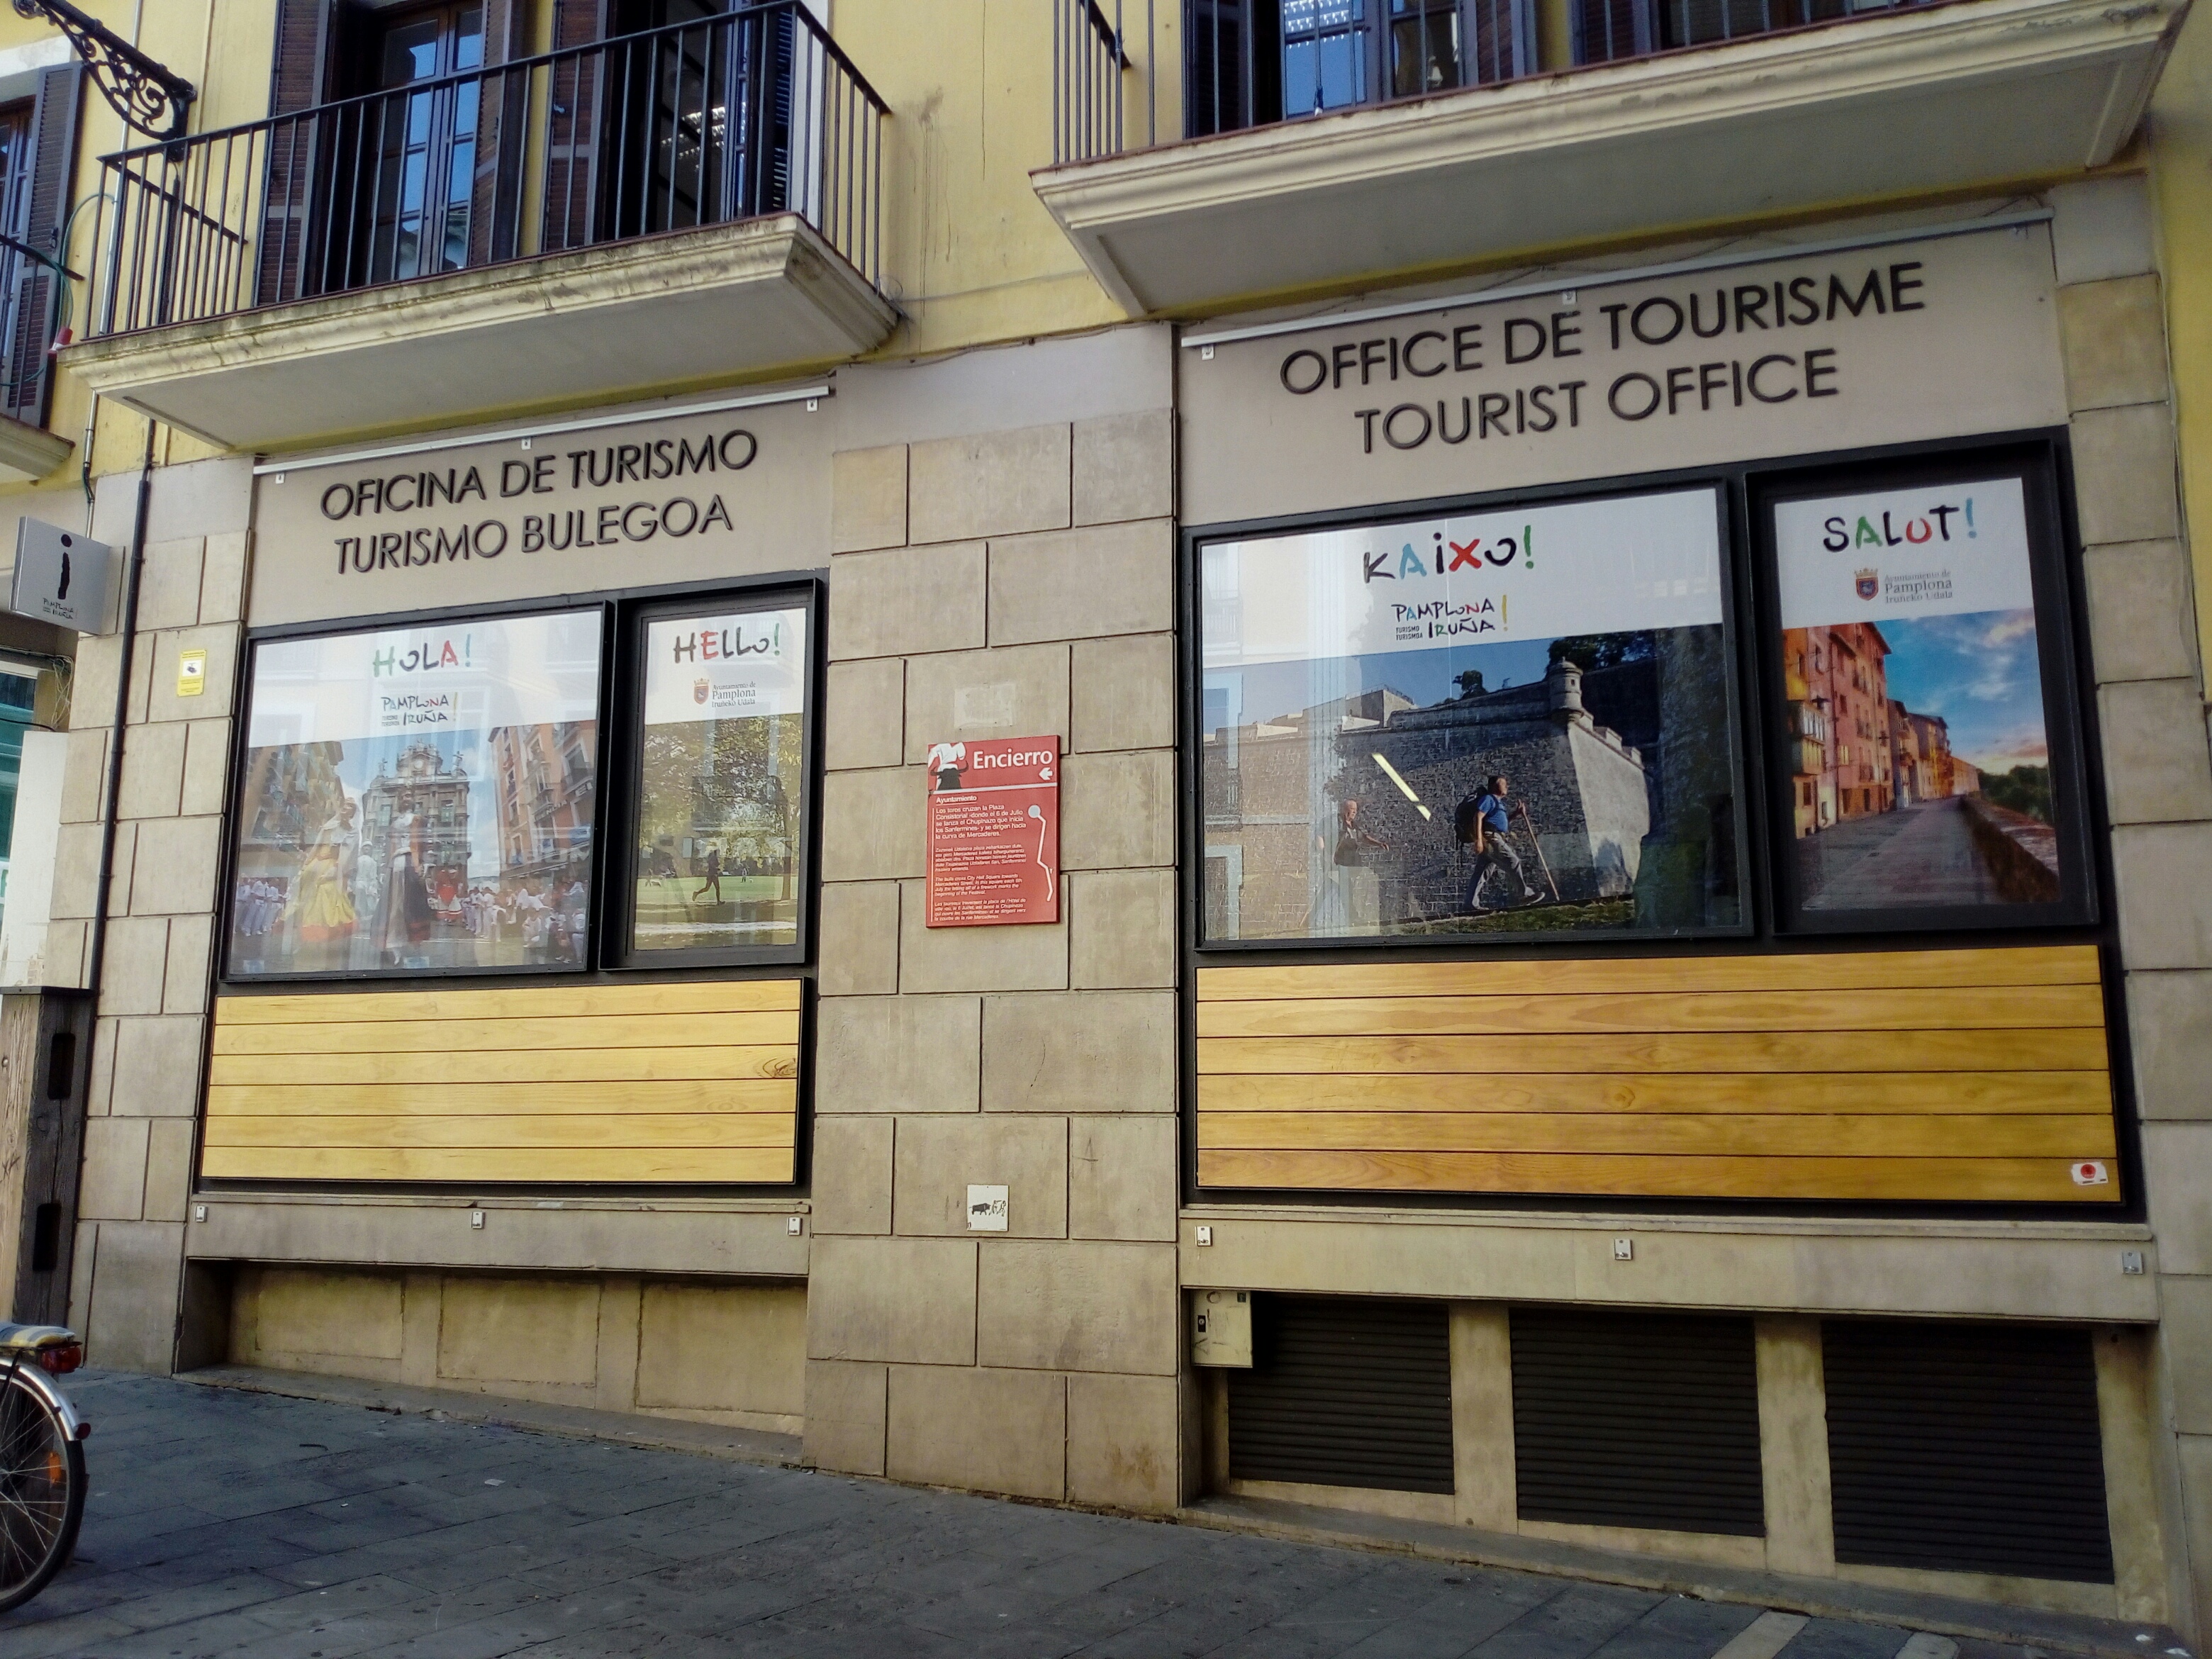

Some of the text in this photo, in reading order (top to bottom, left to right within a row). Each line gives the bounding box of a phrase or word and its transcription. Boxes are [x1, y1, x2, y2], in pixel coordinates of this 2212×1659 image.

[1280, 262, 1926, 395] OFFICE DE TOURISME
[1353, 348, 1838, 454] TOURIST OFFICE
[320, 430, 757, 520] OFICINA DE TURISMO
[334, 494, 733, 574] TURISMO BULEGOA
[1823, 497, 1977, 553] SALUT!
[1885, 579, 1953, 594] Pamplona
[1391, 597, 1495, 622] PAMPLONA
[1396, 625, 1420, 634] TURISMO
[1429, 618, 1496, 638] IRUÑA
[373, 633, 471, 678] HOLA!
[381, 694, 449, 712] PAMPLONA
[713, 688, 756, 701] Pamplona
[737, 698, 756, 706] Udala
[403, 709, 448, 726] IRUÑA
[973, 748, 1054, 770] Encierro
[936, 795, 977, 804] Ayuntamiento
